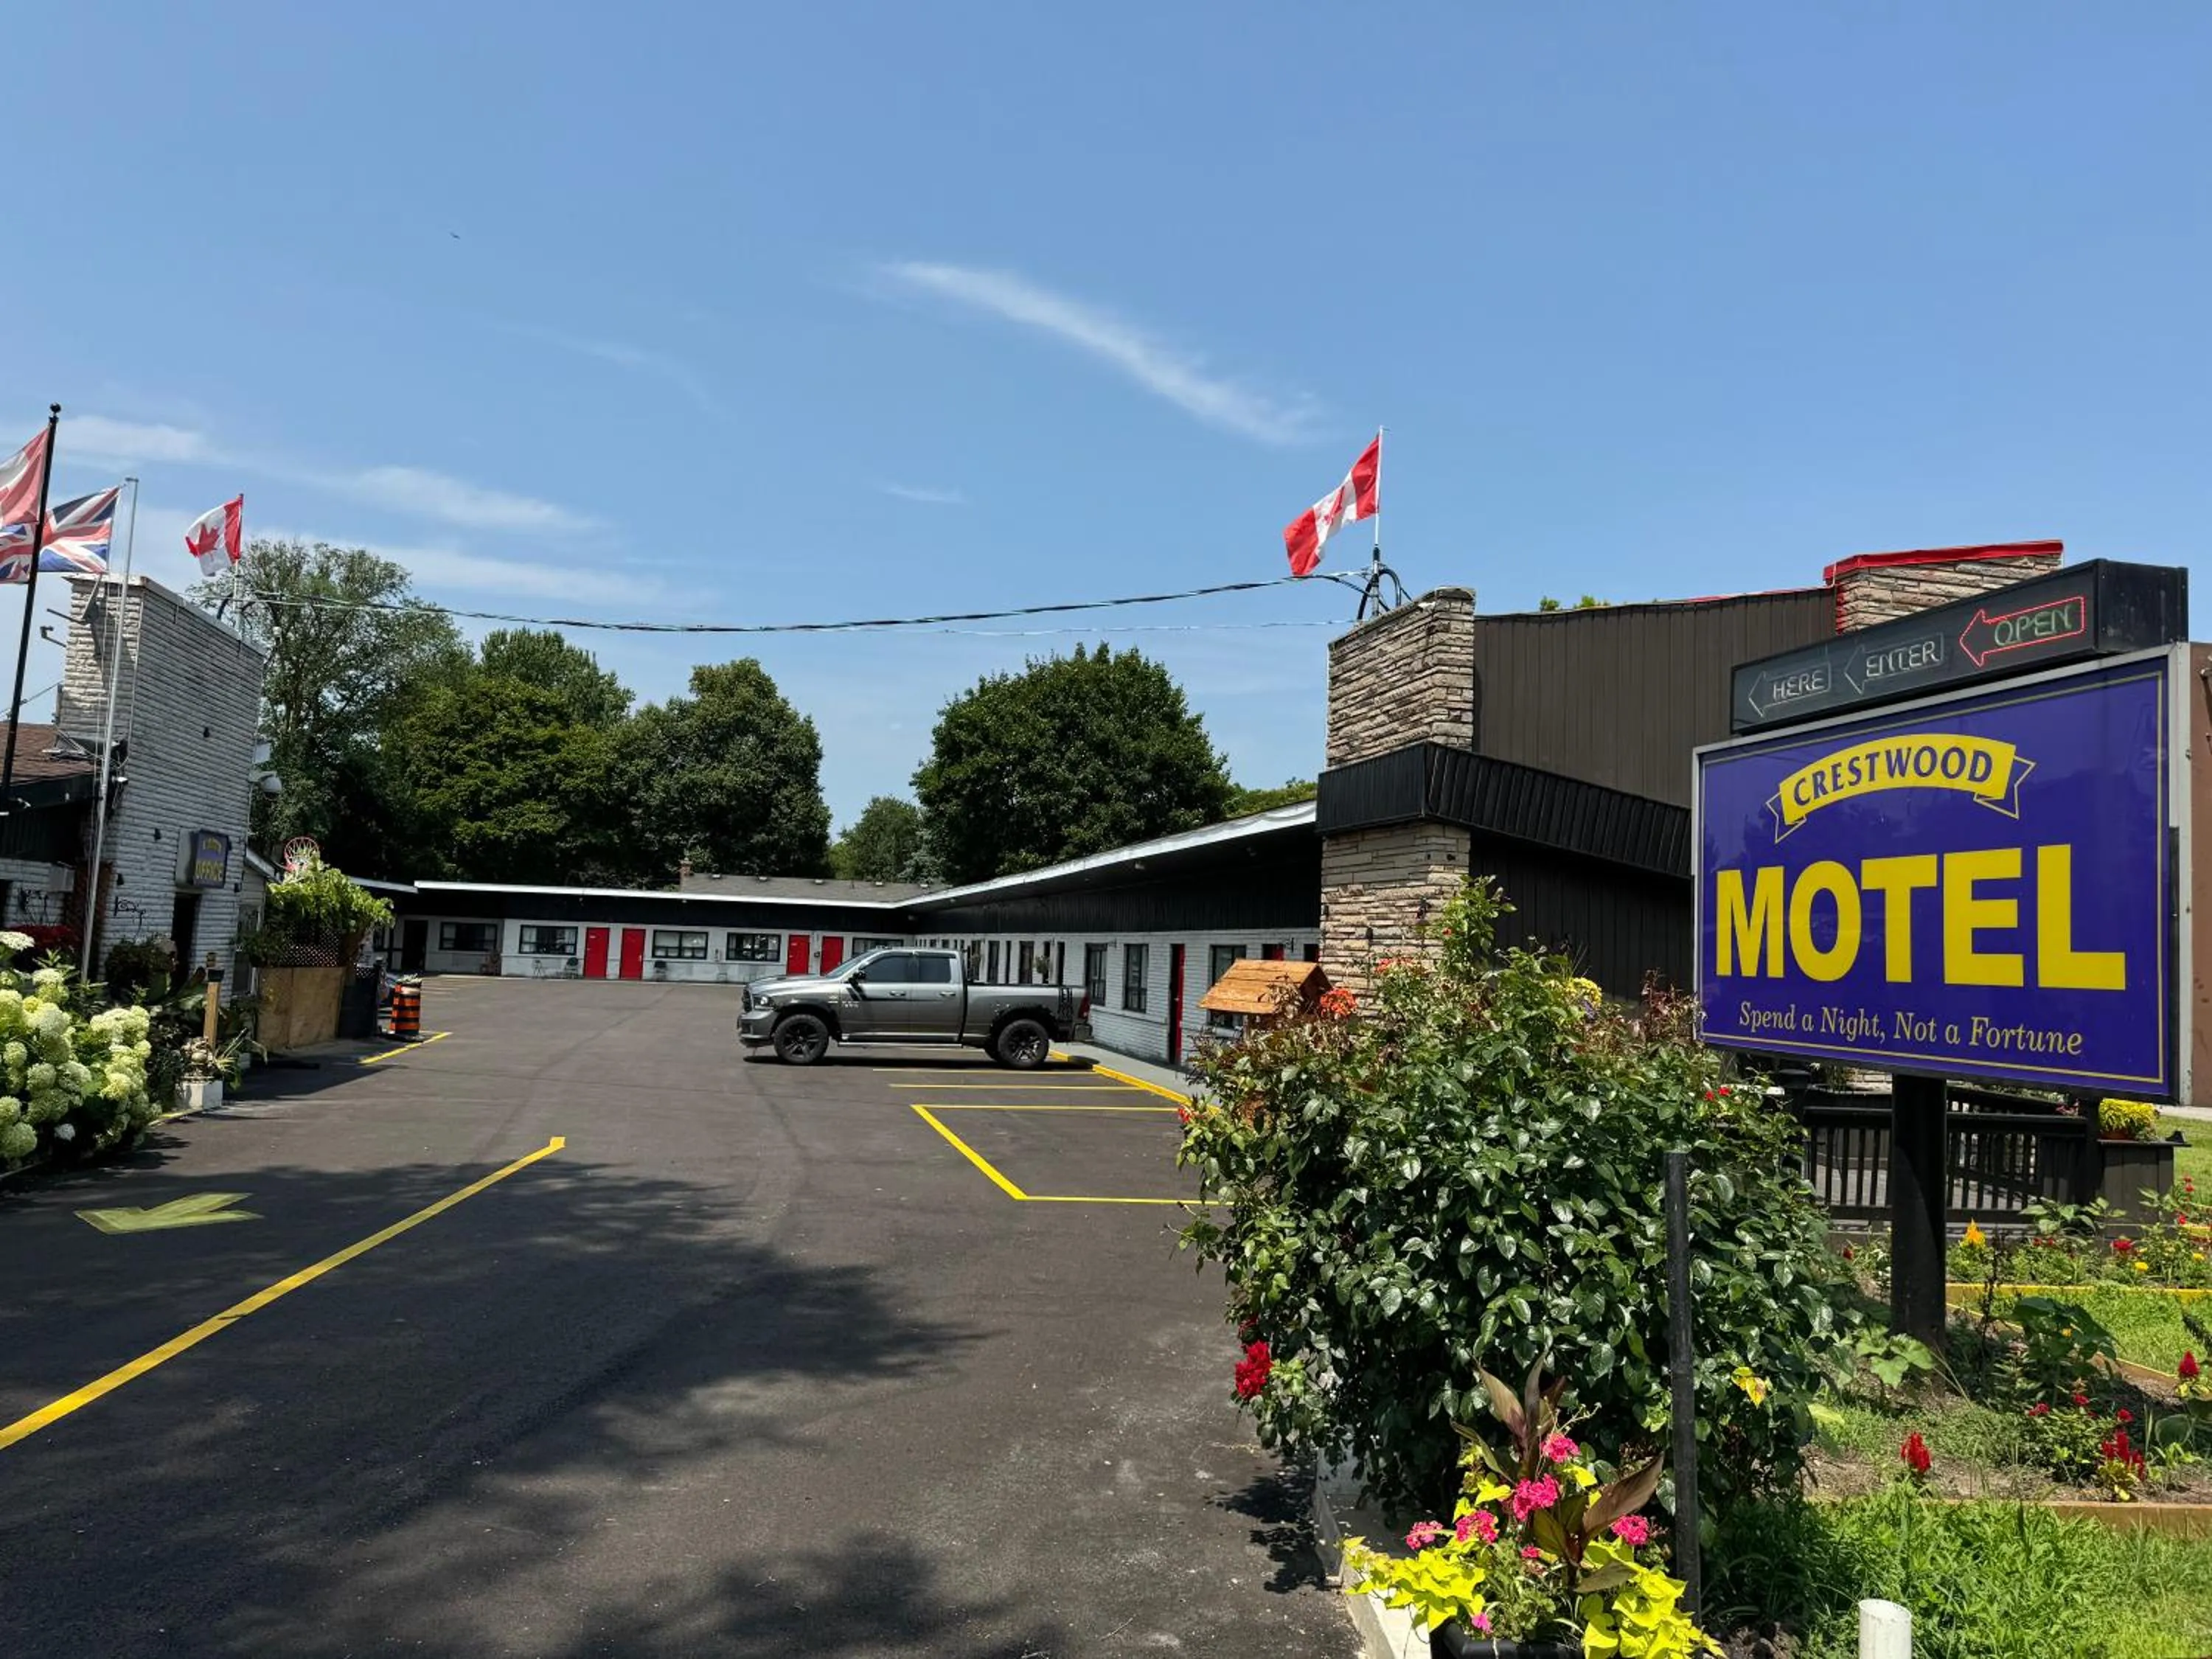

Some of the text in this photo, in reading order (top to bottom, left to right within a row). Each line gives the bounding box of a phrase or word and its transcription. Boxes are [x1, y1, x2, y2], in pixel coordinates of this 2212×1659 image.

[1773, 606, 2071, 696] HERE ENTER OPEN
[1793, 745, 1992, 806] CRESTWOOD
[1716, 844, 2126, 990] MOTEL
[1739, 1001, 2084, 1056] Spend a Night, Not a Fortune
